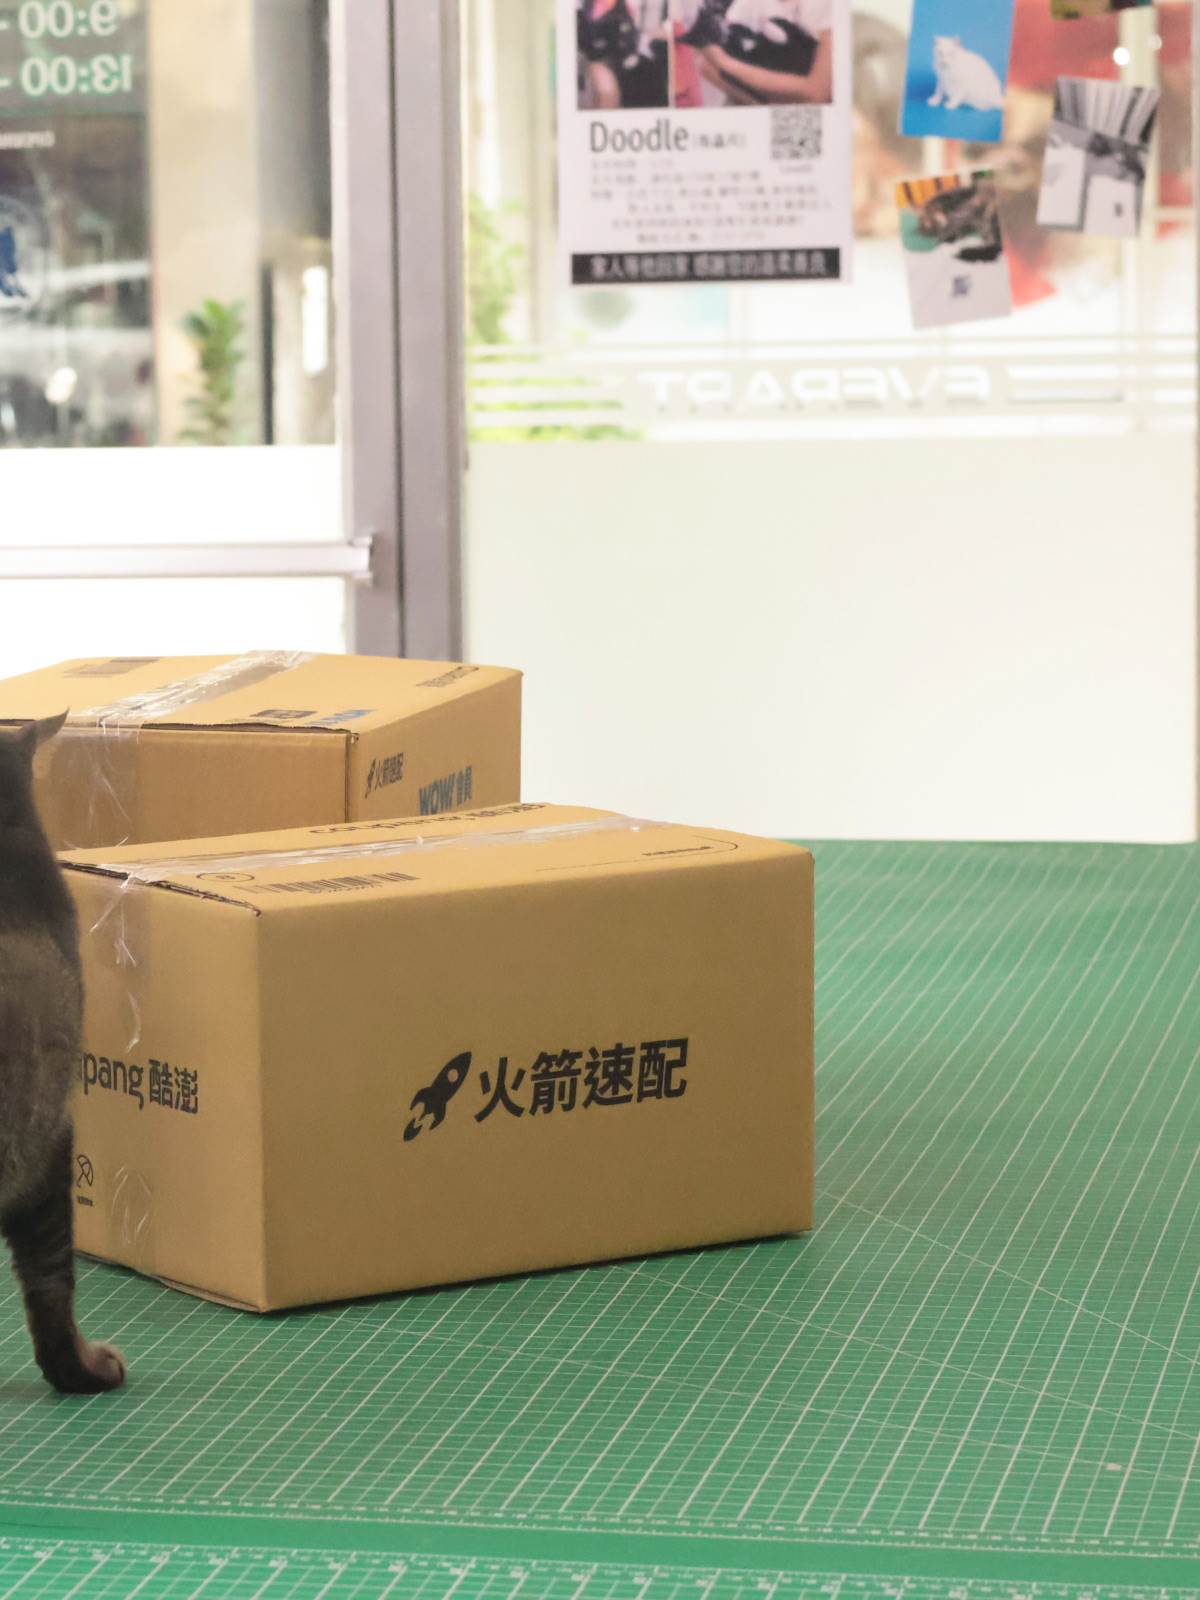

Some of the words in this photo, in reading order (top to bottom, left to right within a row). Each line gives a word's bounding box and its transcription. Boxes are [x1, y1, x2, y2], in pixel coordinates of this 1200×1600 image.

[589, 119, 689, 152] Doodle
[81, 1052, 145, 1110] pang
[148, 1058, 199, 1115] 酷澎
[474, 1038, 689, 1122] 火箭速配
